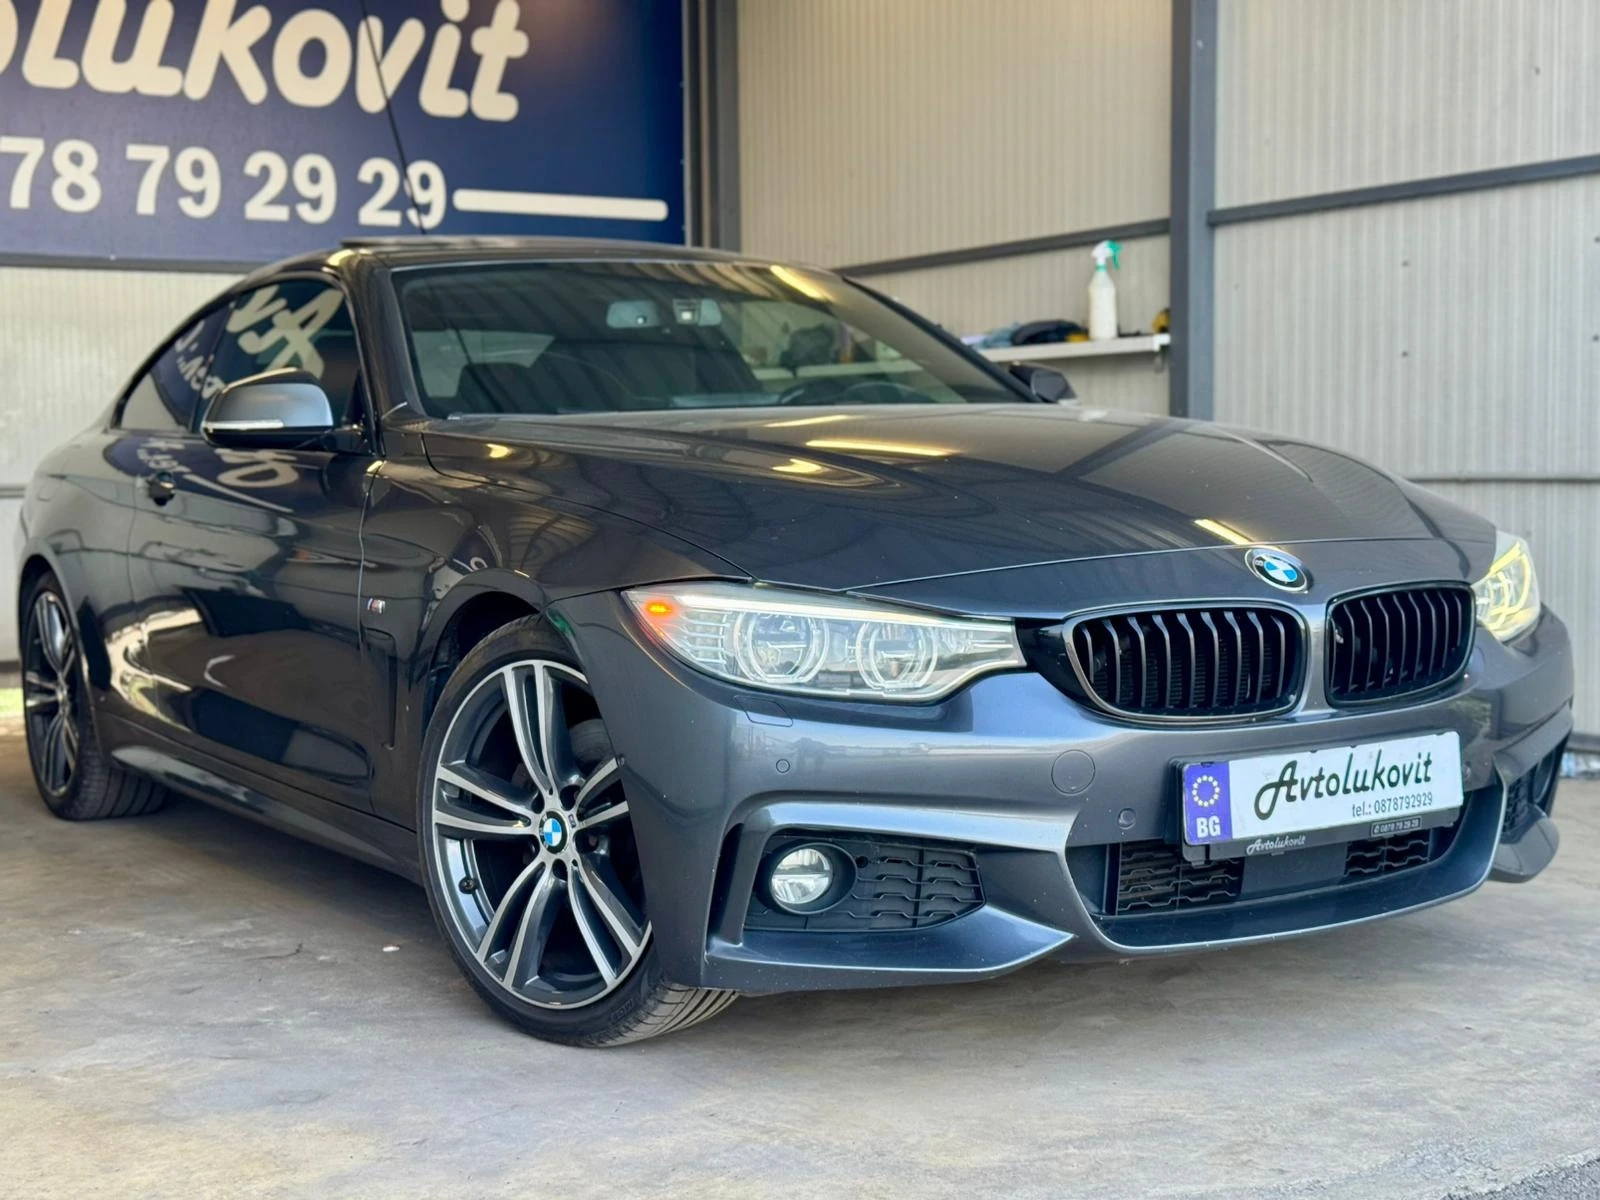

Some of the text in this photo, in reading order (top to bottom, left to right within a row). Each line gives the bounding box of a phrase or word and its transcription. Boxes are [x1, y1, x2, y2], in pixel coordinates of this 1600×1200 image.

[0, 0, 529, 121] lukovit
[126, 144, 221, 218] 79
[244, 151, 337, 223] 29
[357, 157, 447, 229] 29
[1254, 749, 1432, 821] Avtolukovit
[1374, 791, 1433, 814] 0878792929
[1196, 815, 1221, 838] BG
